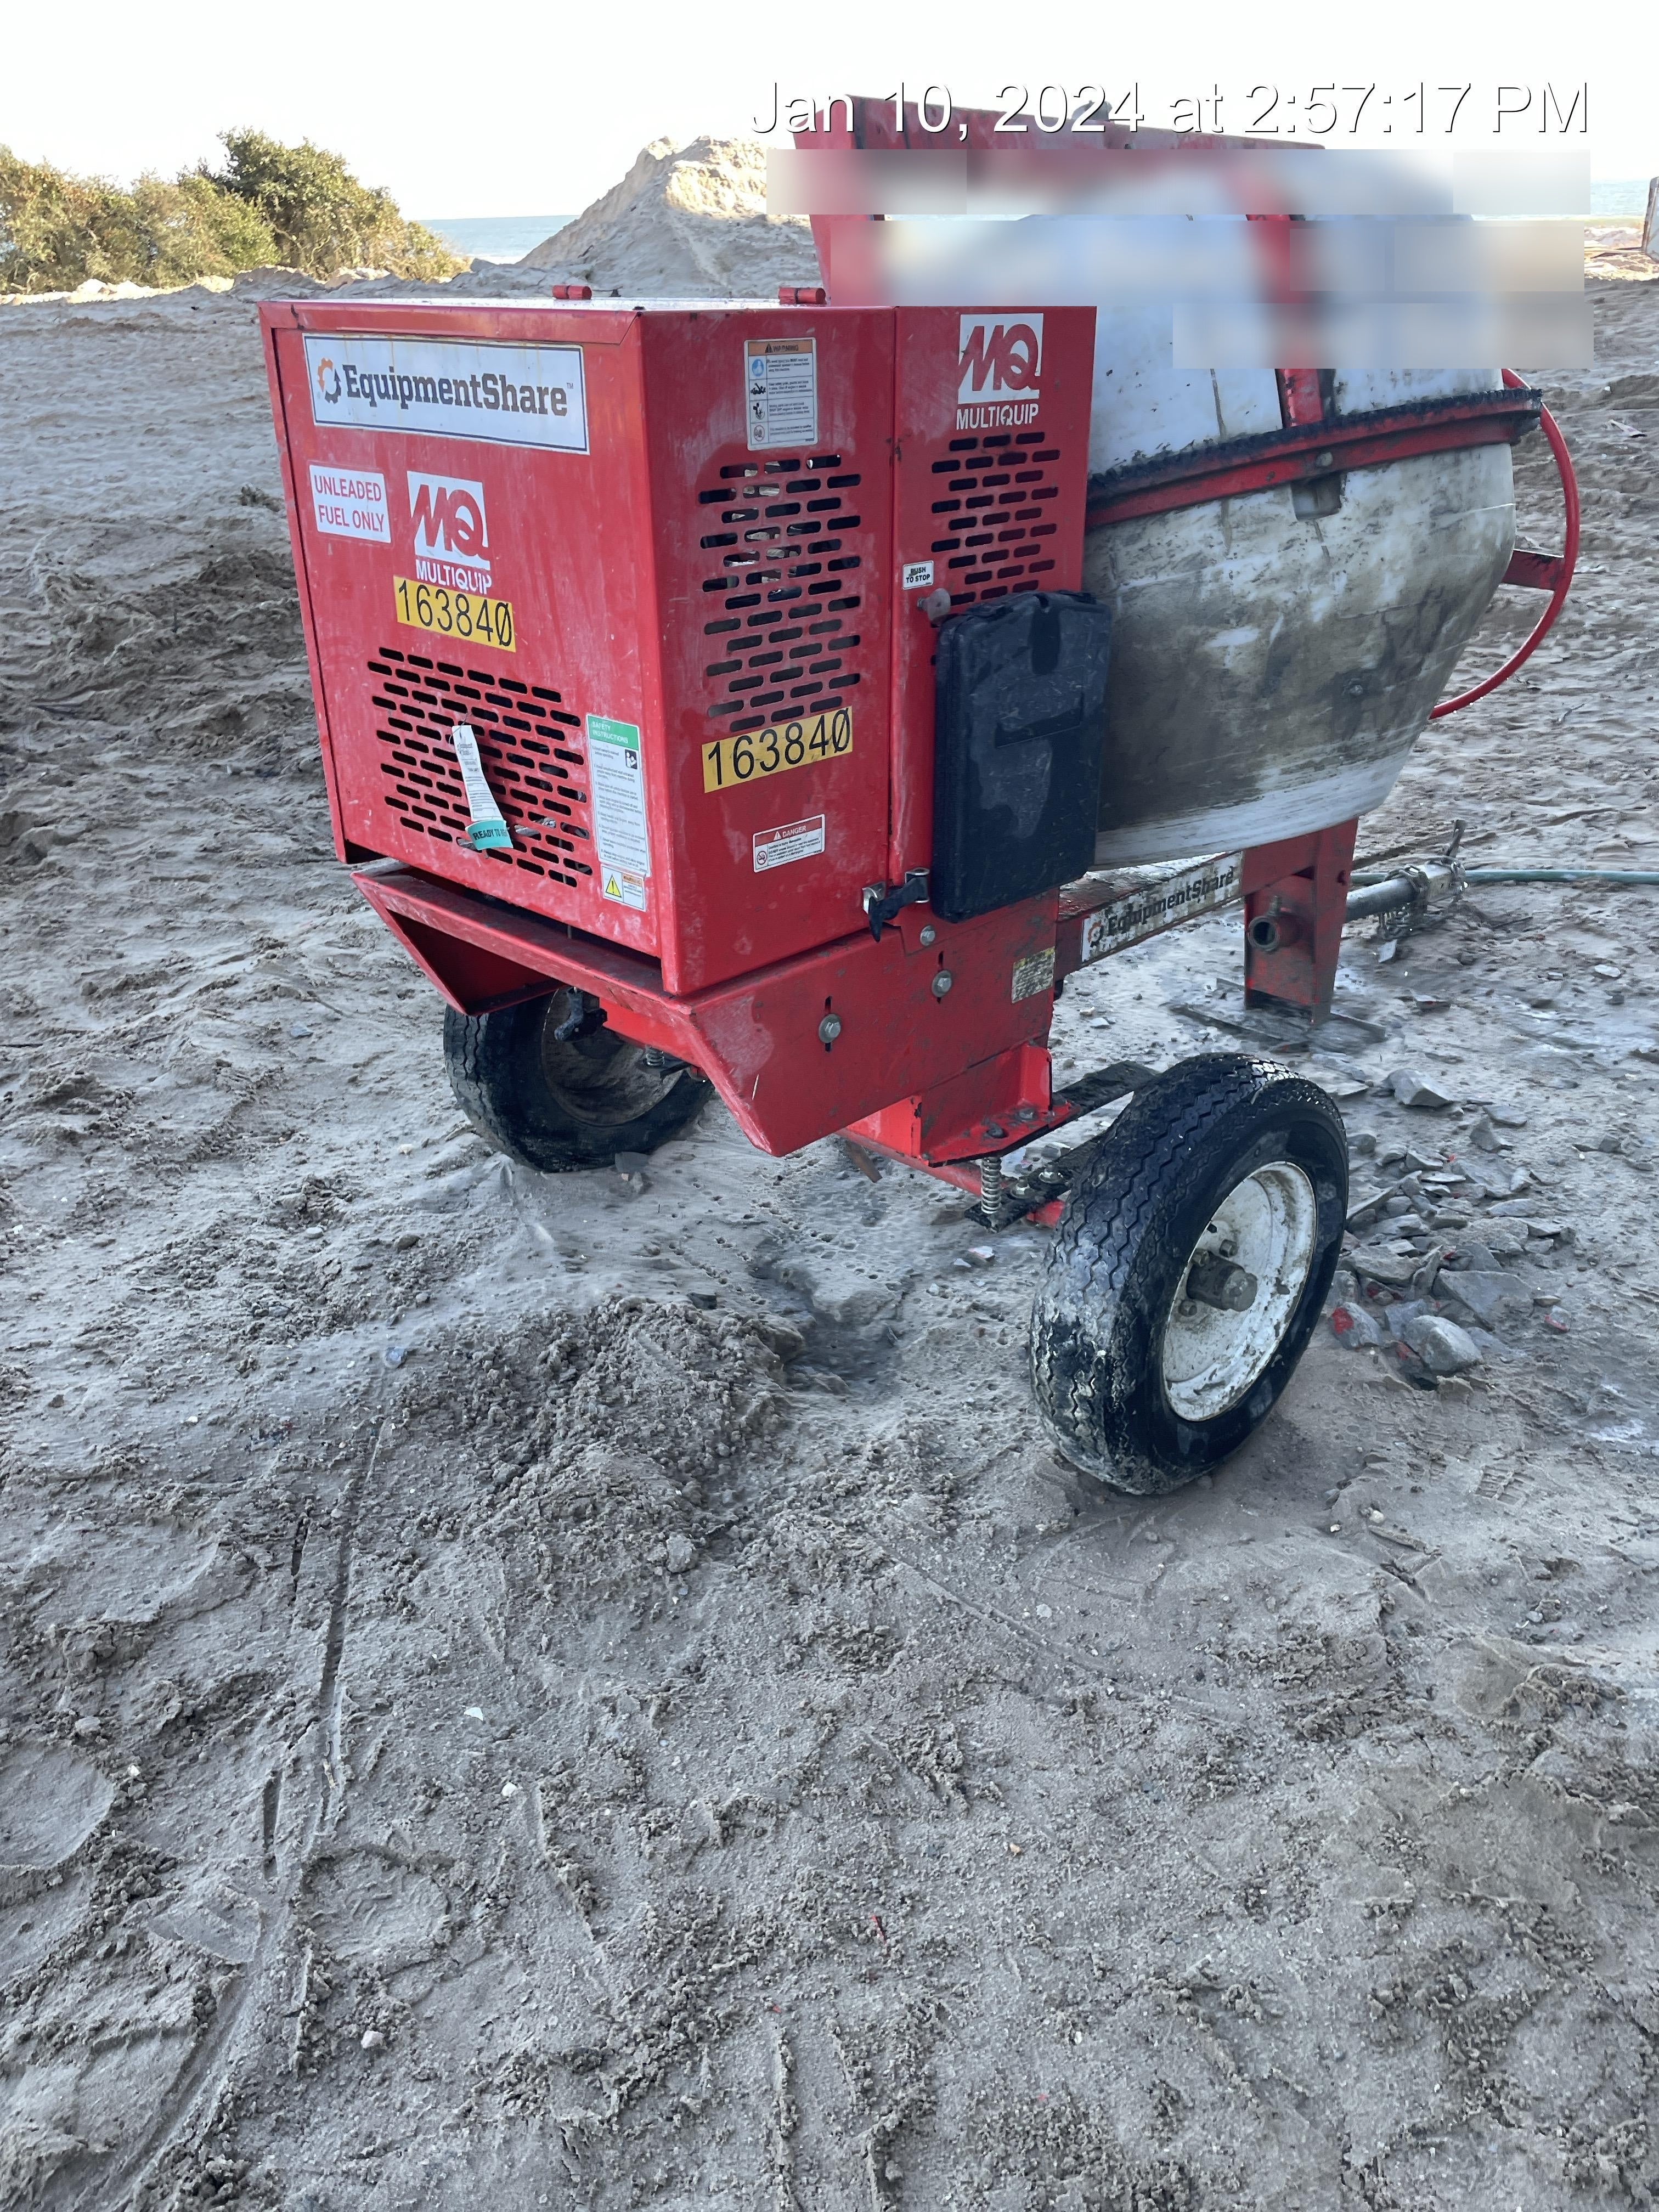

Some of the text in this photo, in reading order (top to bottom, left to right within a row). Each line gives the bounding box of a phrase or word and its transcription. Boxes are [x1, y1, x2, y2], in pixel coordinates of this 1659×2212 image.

[957, 323, 1040, 392] MQ
[342, 364, 568, 417] EquipmentShare
[956, 403, 1039, 430] MULTIQUIP
[314, 474, 382, 503] UNLEADED
[318, 504, 385, 533] FUEL ONLY
[410, 483, 490, 557] MQ
[415, 559, 492, 595] MULTIQUIP
[398, 579, 512, 647] 163840
[592, 721, 611, 731] SAFETY
[592, 730, 629, 744] INSTRUCTIONS
[708, 707, 850, 786] 163840
[472, 828, 494, 840] READY
[782, 825, 807, 838] DANGER
